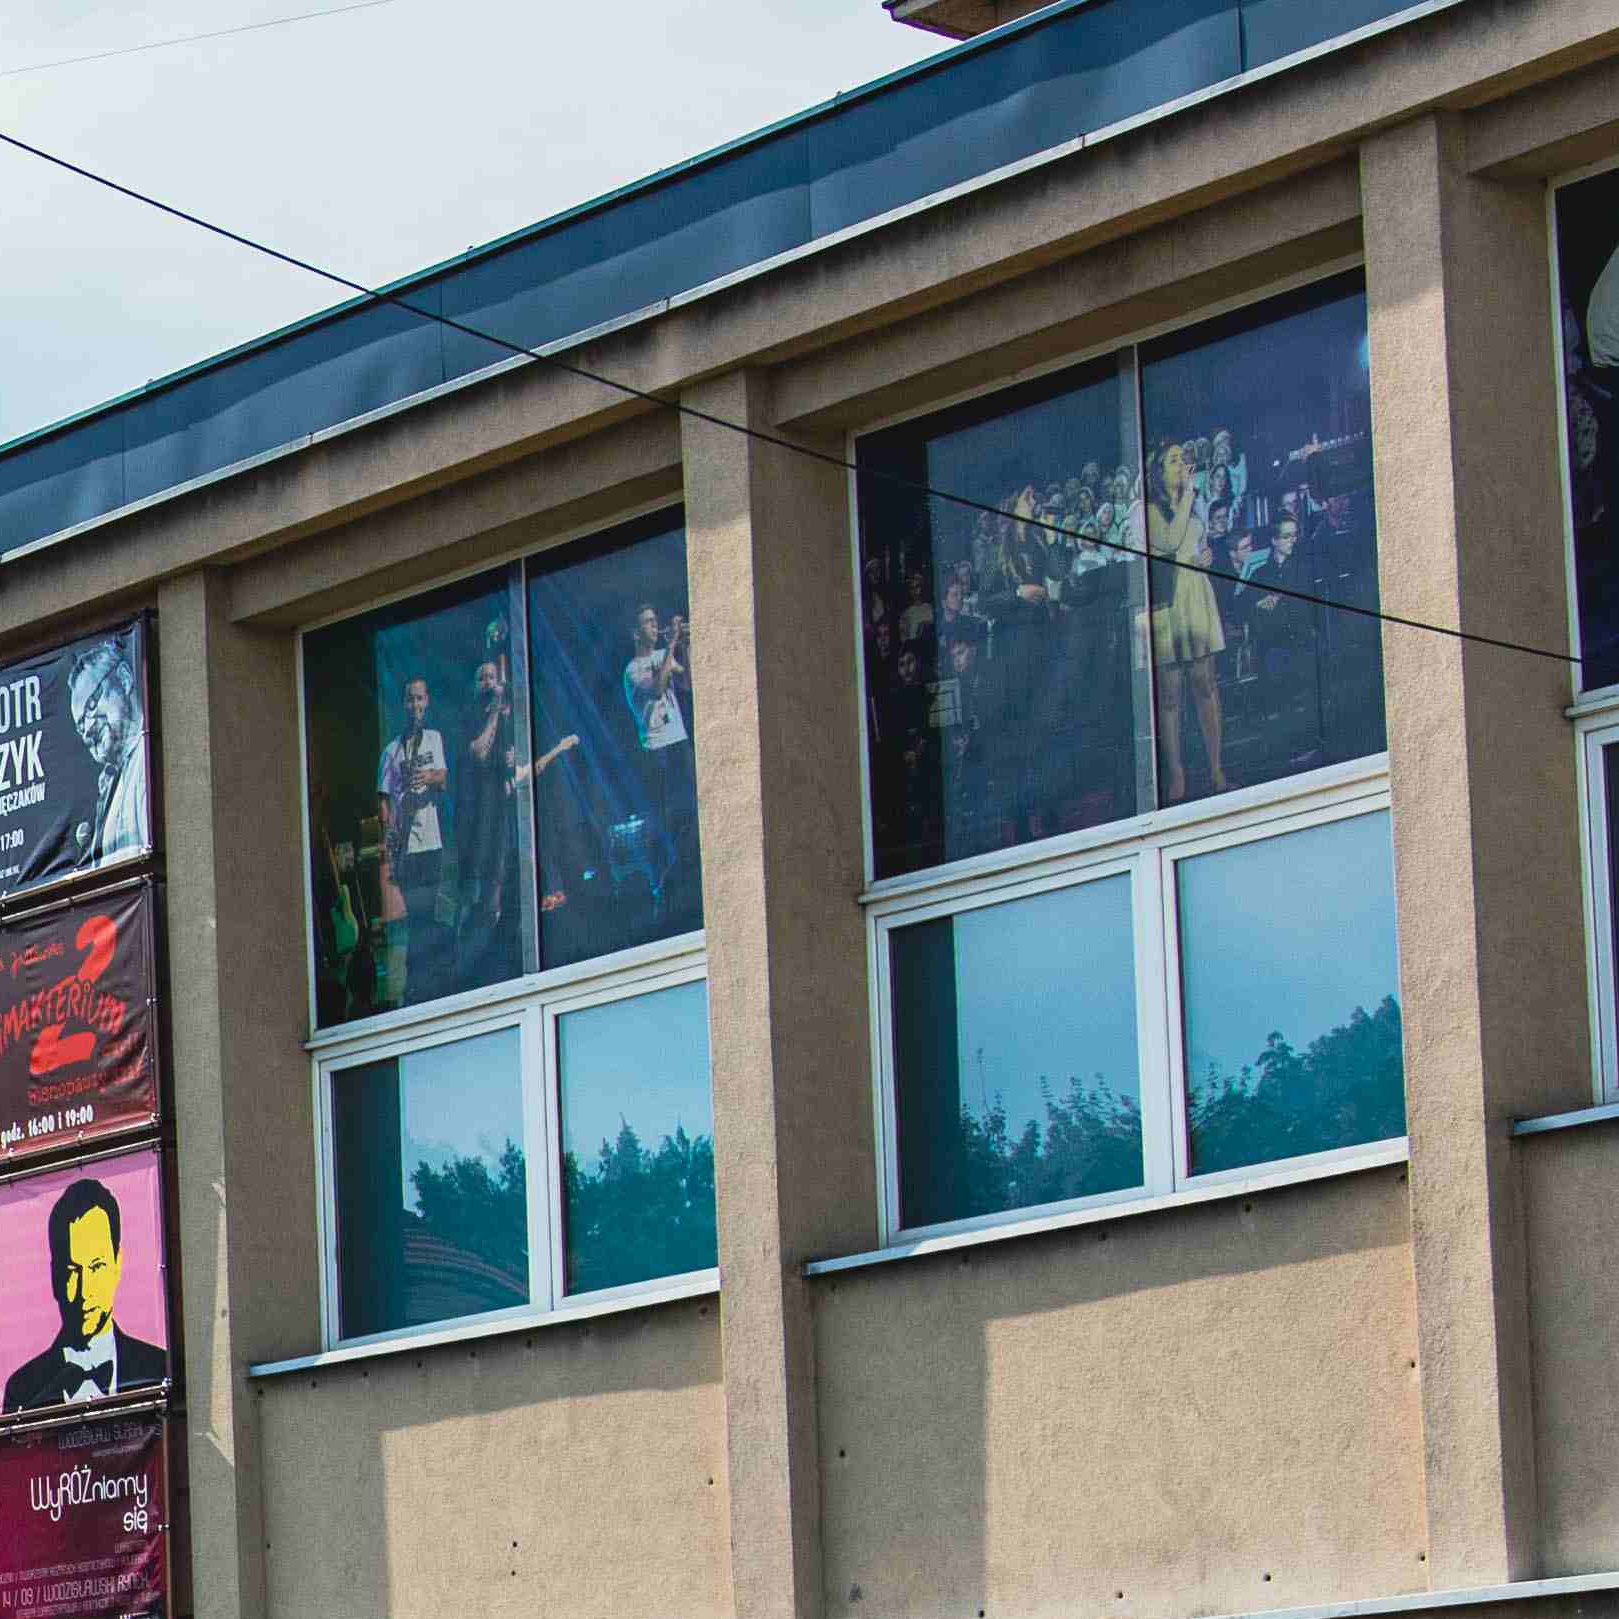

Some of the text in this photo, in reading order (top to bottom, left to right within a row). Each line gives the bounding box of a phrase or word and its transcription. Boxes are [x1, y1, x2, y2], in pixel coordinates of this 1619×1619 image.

[0, 828, 24, 851] 17:00
[0, 1122, 25, 1149] godz.
[27, 1113, 55, 1137] 16:00
[65, 1104, 94, 1128] 19:00
[30, 1464, 148, 1521] WyRÓŻniamy
[123, 1506, 148, 1533] się
